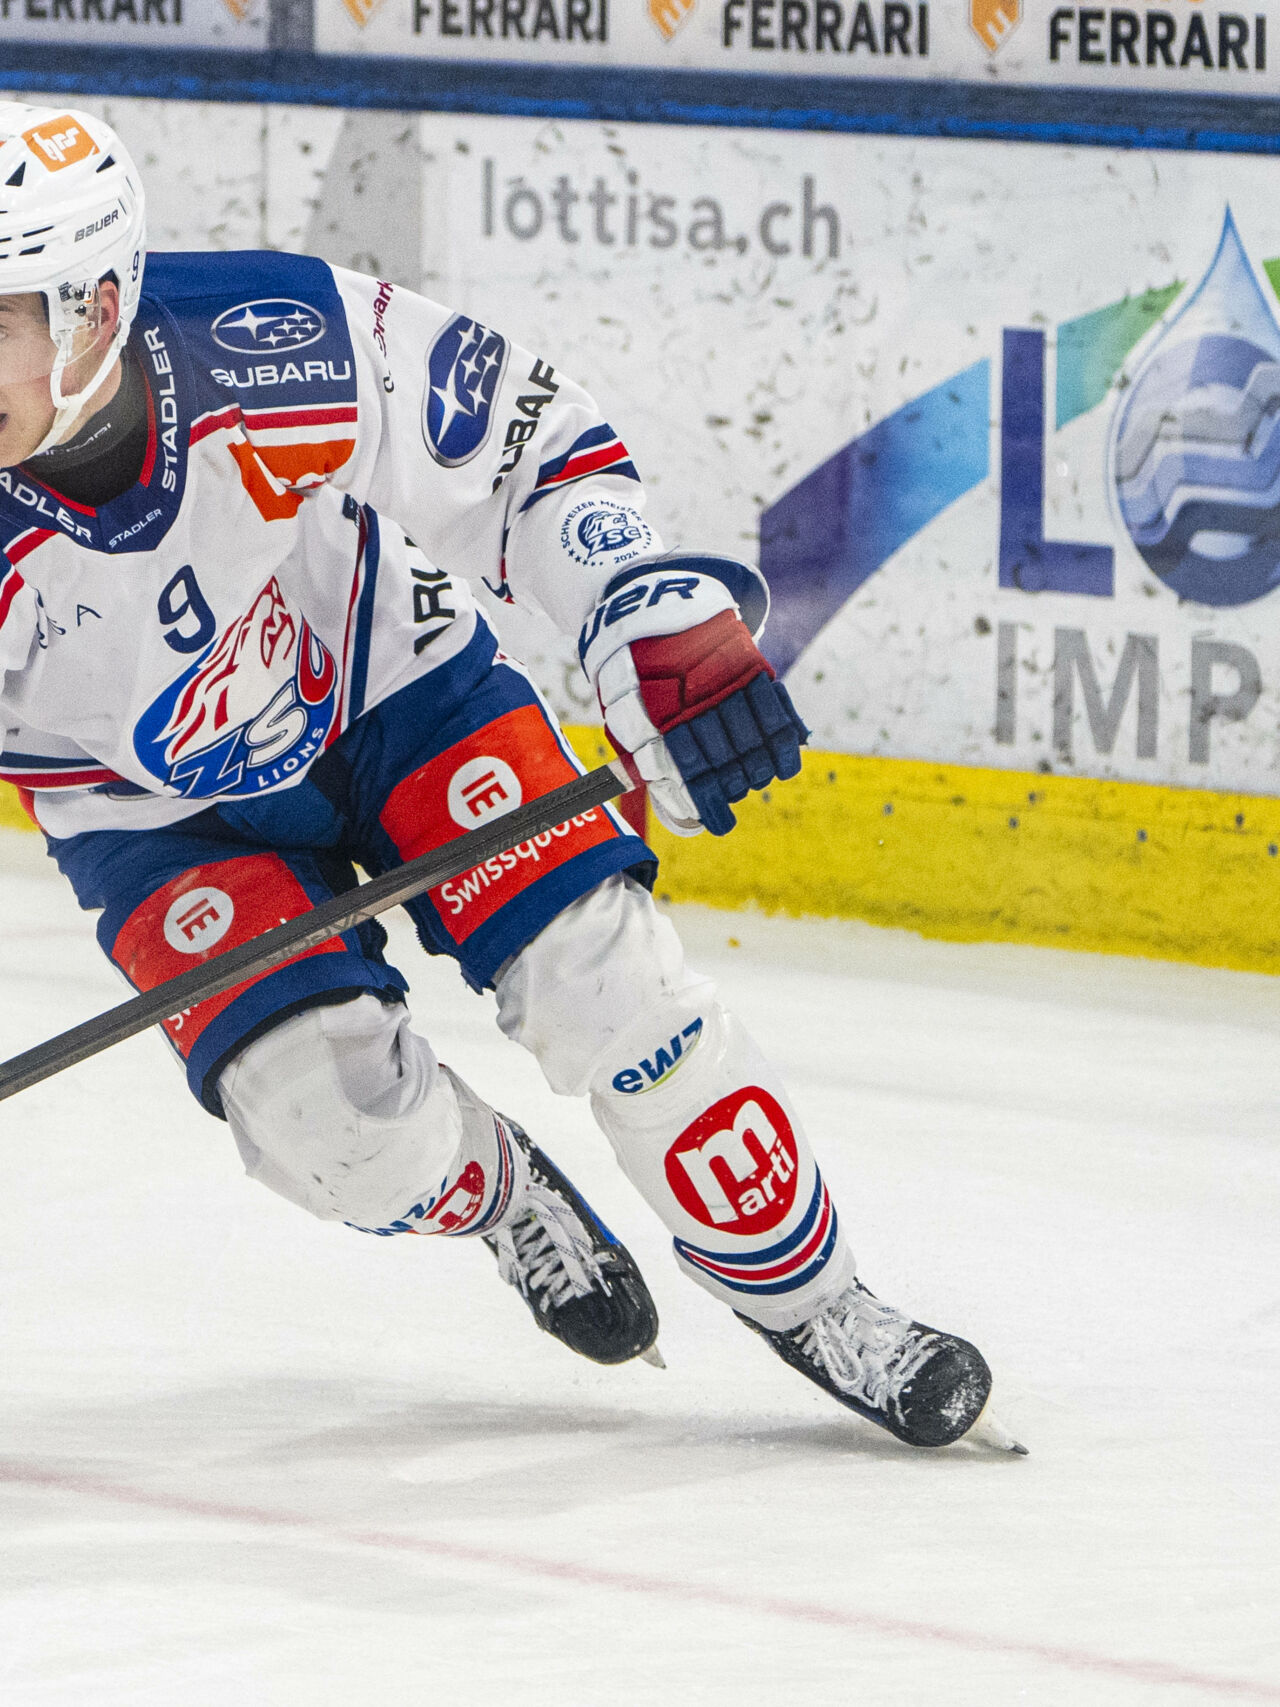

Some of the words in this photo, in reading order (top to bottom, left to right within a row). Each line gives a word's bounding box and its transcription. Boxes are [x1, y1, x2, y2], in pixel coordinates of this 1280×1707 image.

[722, 0, 932, 57] FERRARI
[1048, 6, 1267, 71] FERRARI
[74, 209, 119, 243] BAUER
[482, 158, 842, 260] lottisa.ch
[210, 360, 352, 388] SUBARU
[143, 326, 177, 492] STADLER
[108, 508, 162, 549] STADLER
[157, 564, 217, 654] 9
[995, 620, 1263, 766] IMP
[257, 726, 325, 788] LIONS
